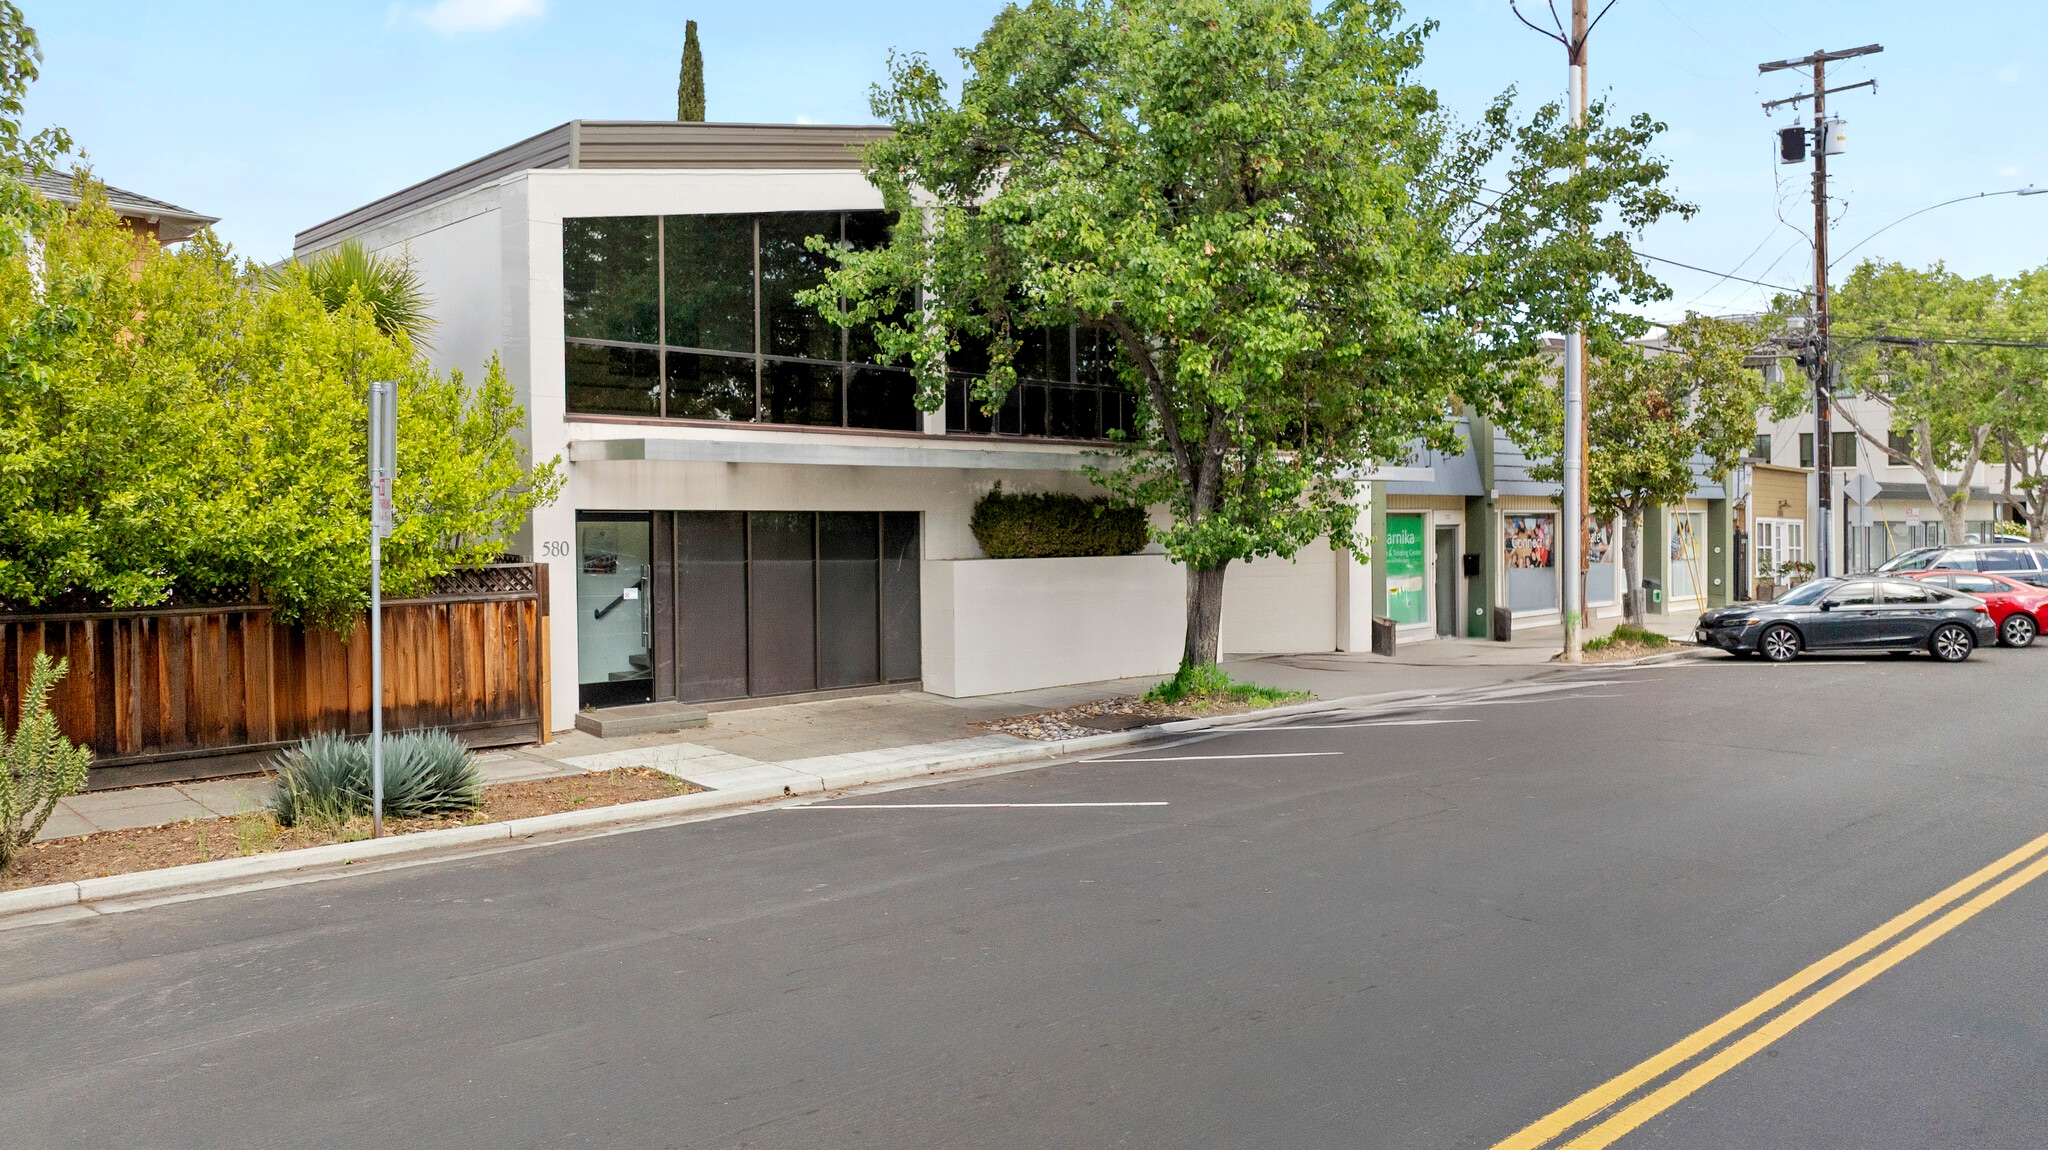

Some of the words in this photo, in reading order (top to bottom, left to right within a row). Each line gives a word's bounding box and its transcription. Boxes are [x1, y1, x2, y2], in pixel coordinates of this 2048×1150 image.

[1386, 529, 1415, 545] arnika
[1511, 535, 1543, 549] Connect
[542, 541, 570, 557] 580
